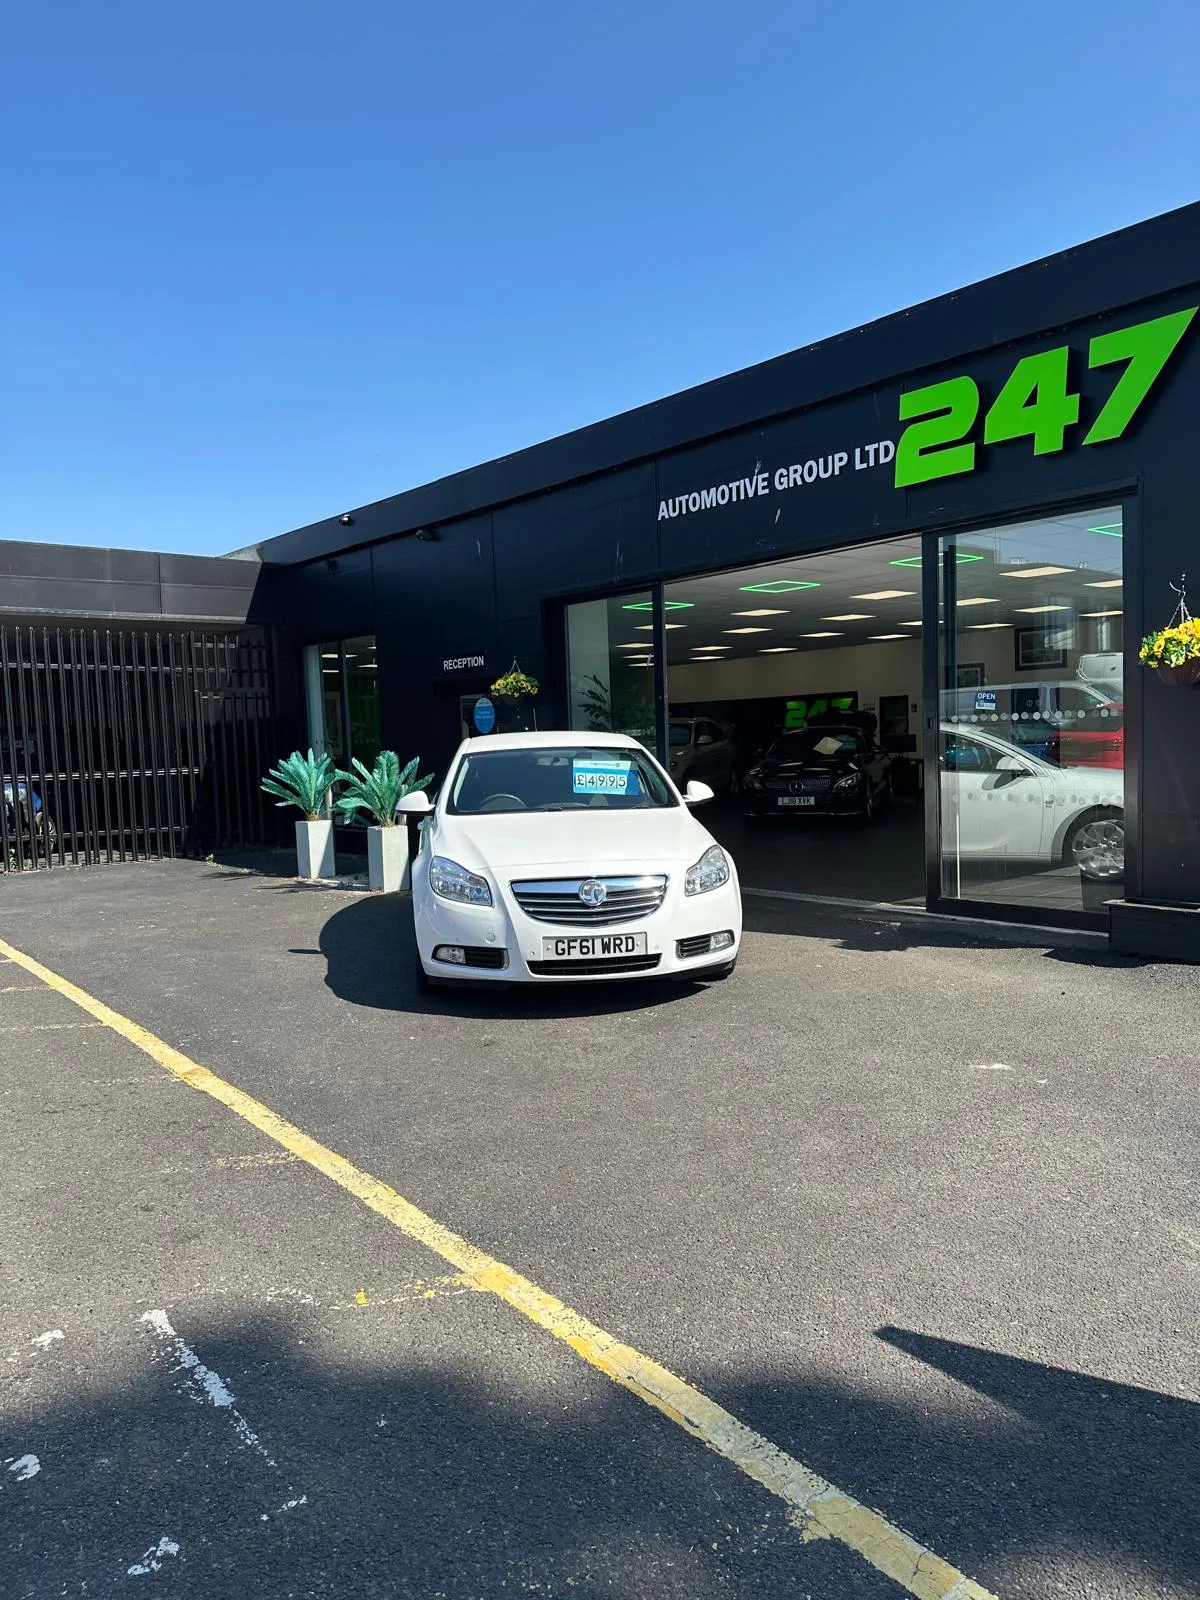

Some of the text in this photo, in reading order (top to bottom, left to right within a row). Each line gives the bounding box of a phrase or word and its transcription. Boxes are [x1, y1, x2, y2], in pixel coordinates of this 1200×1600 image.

[895, 306, 1199, 488] 247
[657, 440, 896, 521] AUTOMOTIVE GROUP LTD
[443, 655, 485, 670] RECEPTION
[977, 692, 996, 700] OPEN
[577, 774, 626, 787] £4995
[555, 936, 635, 956] GF61 WRD
